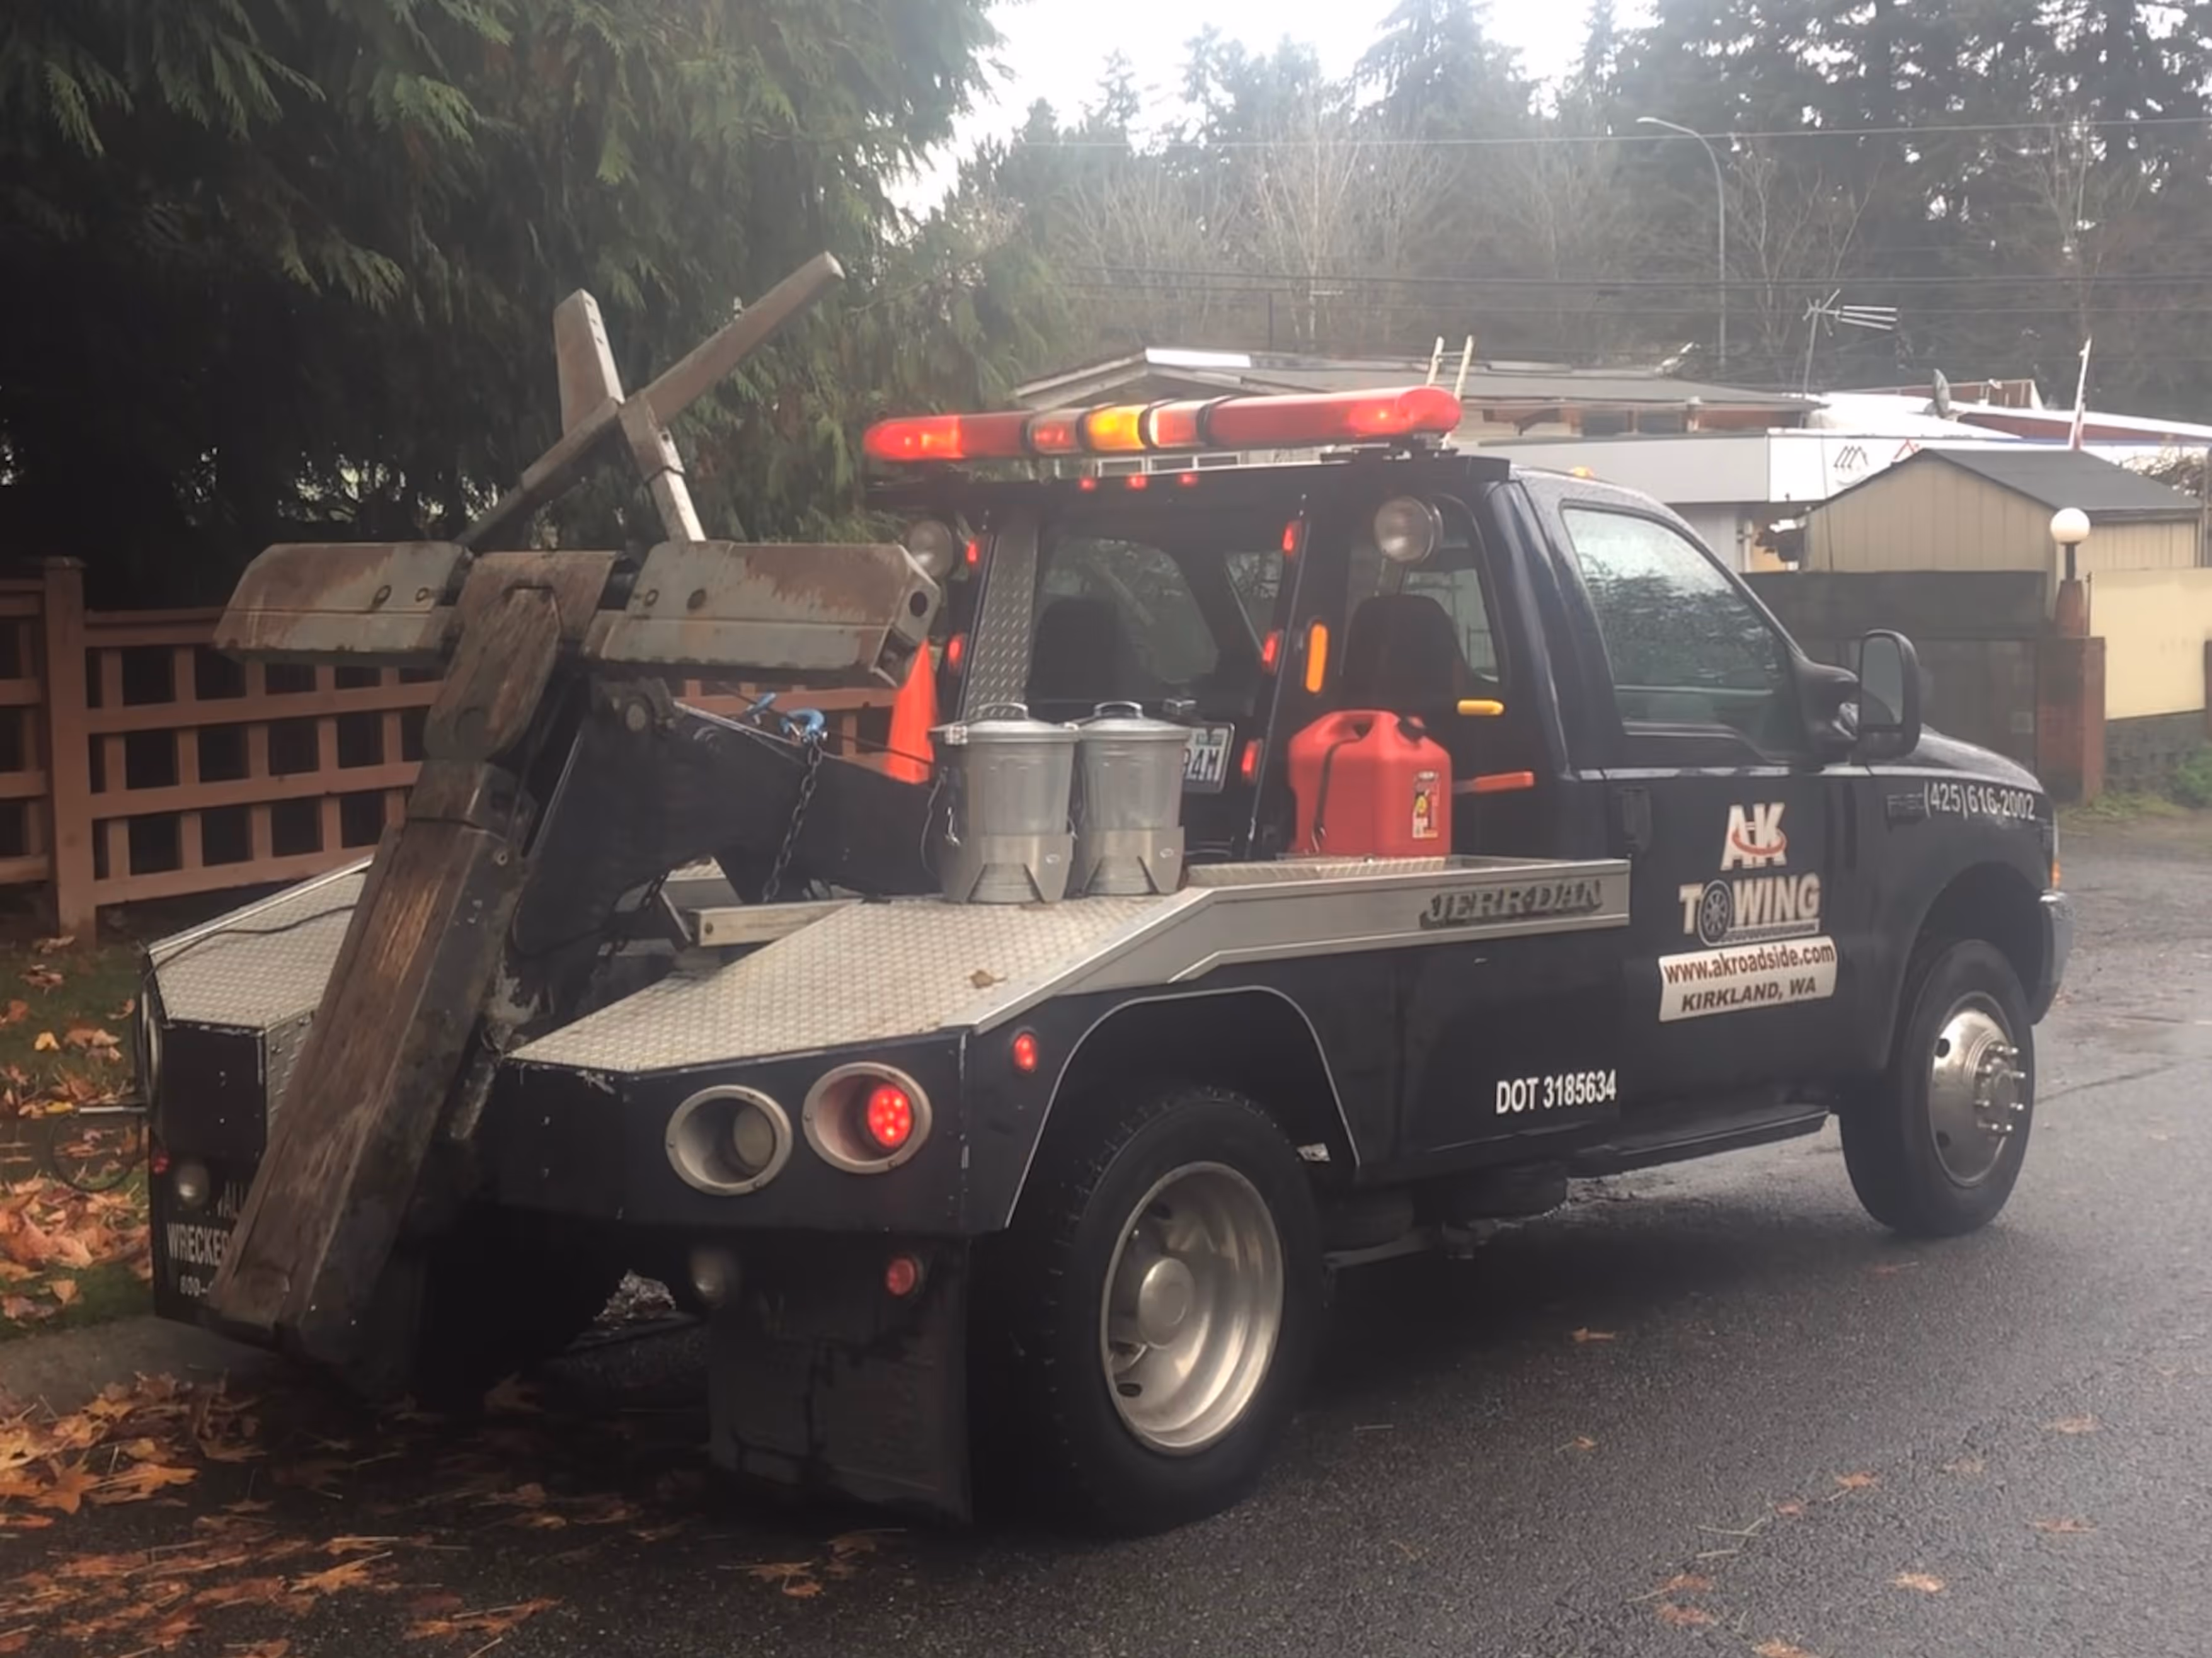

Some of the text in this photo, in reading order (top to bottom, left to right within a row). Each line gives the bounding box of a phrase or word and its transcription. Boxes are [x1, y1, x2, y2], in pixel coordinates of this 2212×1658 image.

[1720, 802, 1787, 871] AK
[1678, 872, 1820, 946] TOWING
[1665, 944, 1835, 984] www.akroadside.com
[1682, 977, 1816, 1012] KIRKLAND, WA
[1496, 1069, 1617, 1114] DOT 3185634
